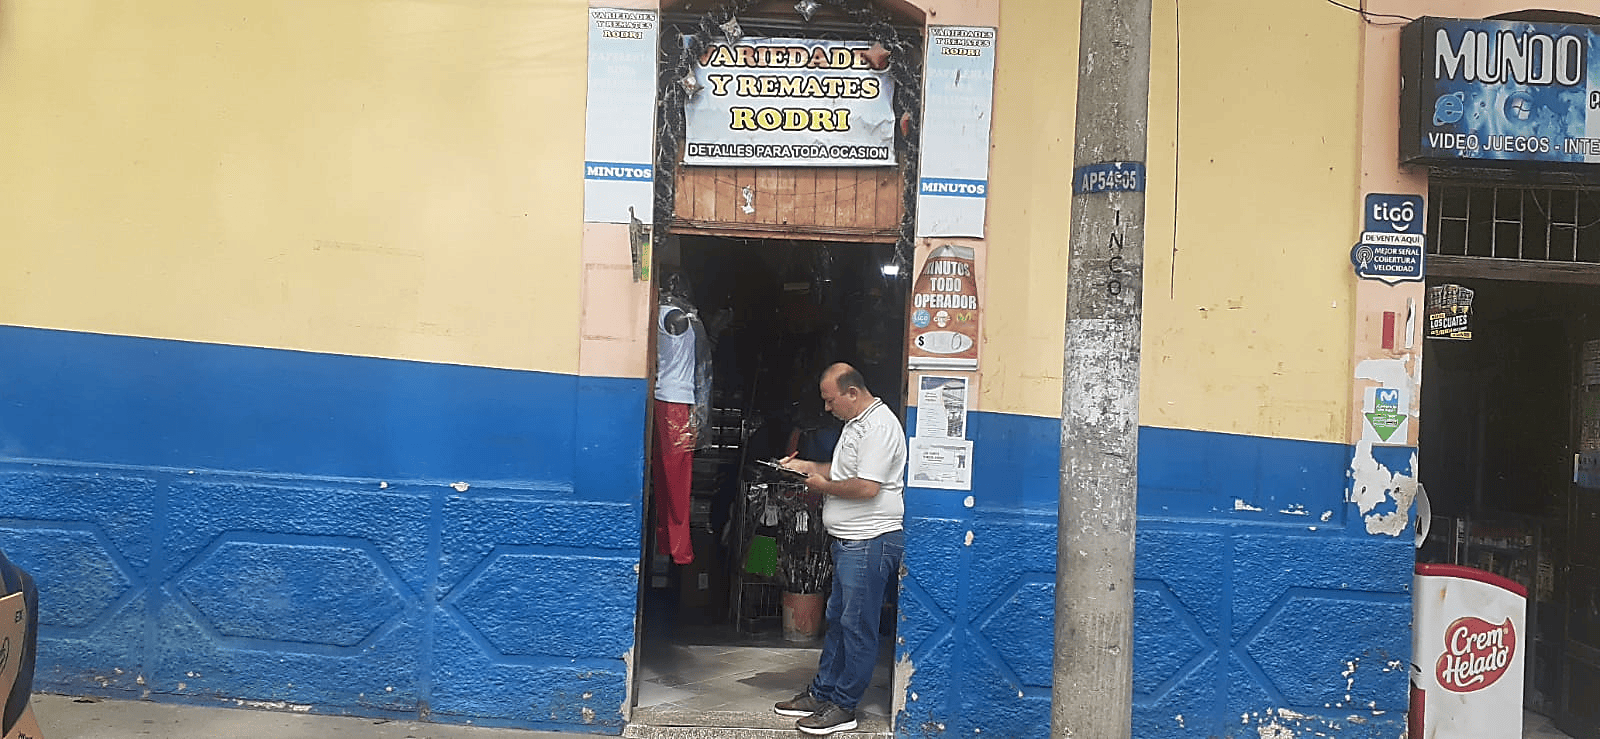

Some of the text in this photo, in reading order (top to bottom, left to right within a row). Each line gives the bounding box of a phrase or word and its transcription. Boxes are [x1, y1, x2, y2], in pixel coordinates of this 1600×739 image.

[591, 12, 656, 21] VARIEDADES
[606, 21, 653, 29] REMATES
[603, 30, 643, 39] RODRI
[931, 28, 994, 38] VARIEDADES
[935, 38, 990, 48] Y REMATES
[941, 47, 981, 57] RODRI
[1435, 28, 1582, 85] MUNDO
[708, 74, 880, 98] Y REMATES
[729, 107, 851, 132] RODRI
[1428, 132, 1479, 151] VIDEO
[1483, 135, 1550, 153] JUEGOS
[688, 143, 889, 160] DETALLES PARA TODA OCASION
[586, 165, 652, 179] MINUTOS
[922, 181, 985, 195] MINUTOS
[1397, 248, 1420, 256] SEÑAL
[1374, 256, 1416, 264] COBERTURA
[1374, 264, 1414, 272] VELOCIDAD
[930, 277, 962, 292] TODO
[914, 293, 977, 310] OPERADOR
[1430, 319, 1443, 329] LOS
[1443, 315, 1468, 329] CUATES
[1451, 626, 1504, 657] Crem
[1442, 646, 1509, 687] Helado
